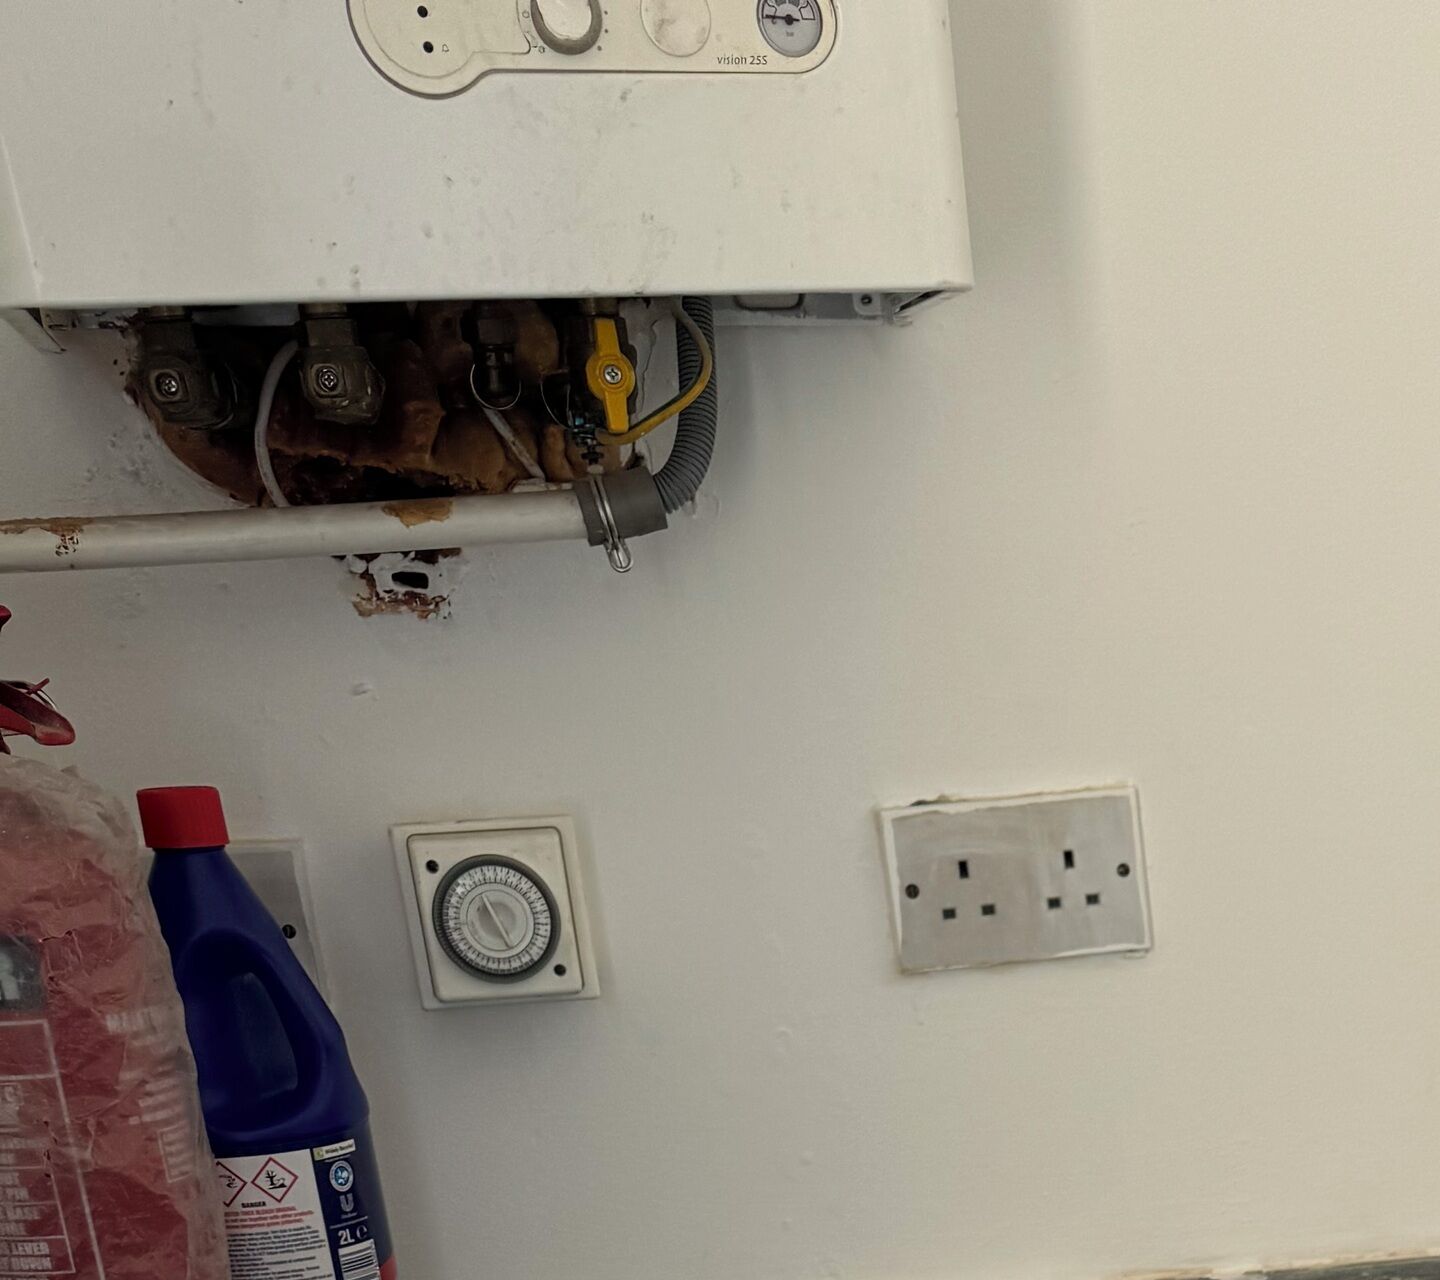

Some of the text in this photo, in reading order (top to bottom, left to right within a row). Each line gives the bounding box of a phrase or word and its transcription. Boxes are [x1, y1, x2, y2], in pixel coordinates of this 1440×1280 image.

[717, 55, 768, 65] vision 25S
[338, 1230, 356, 1245] 2L
[11, 1242, 49, 1256] LEVER
